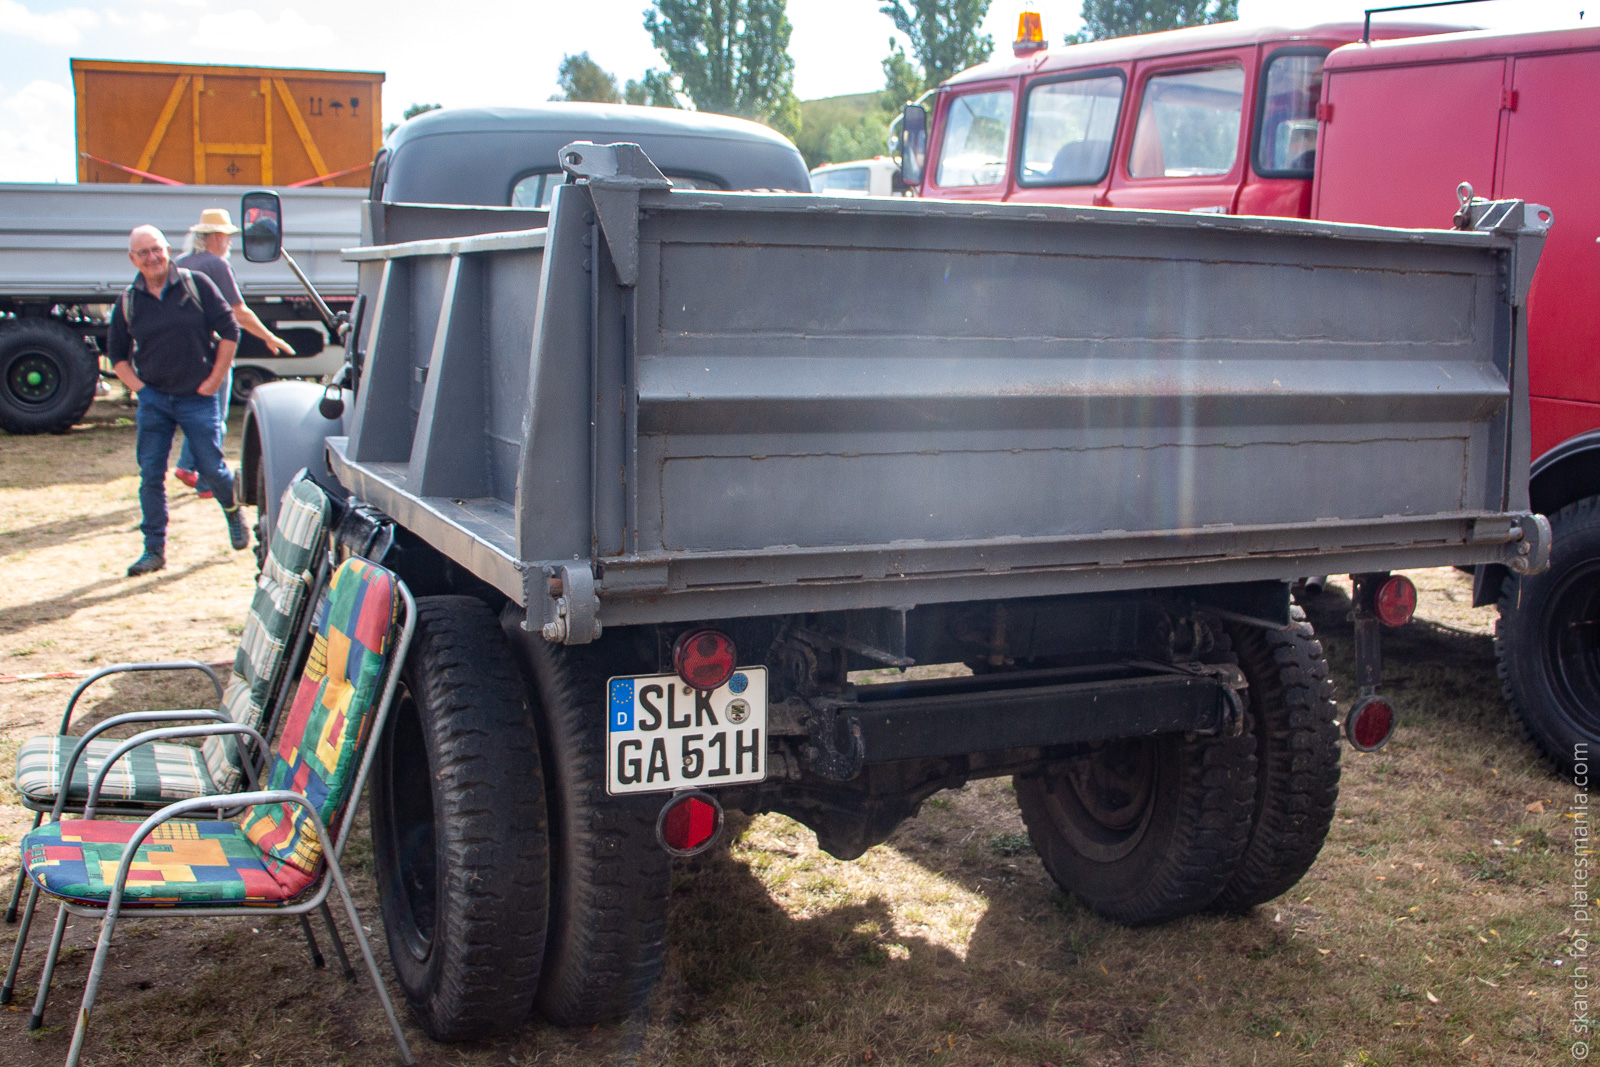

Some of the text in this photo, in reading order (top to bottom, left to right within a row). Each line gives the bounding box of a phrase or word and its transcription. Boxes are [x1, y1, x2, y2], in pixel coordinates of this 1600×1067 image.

[617, 712, 628, 726] D
[638, 683, 719, 731] SLK
[617, 727, 760, 785] GA 51H
